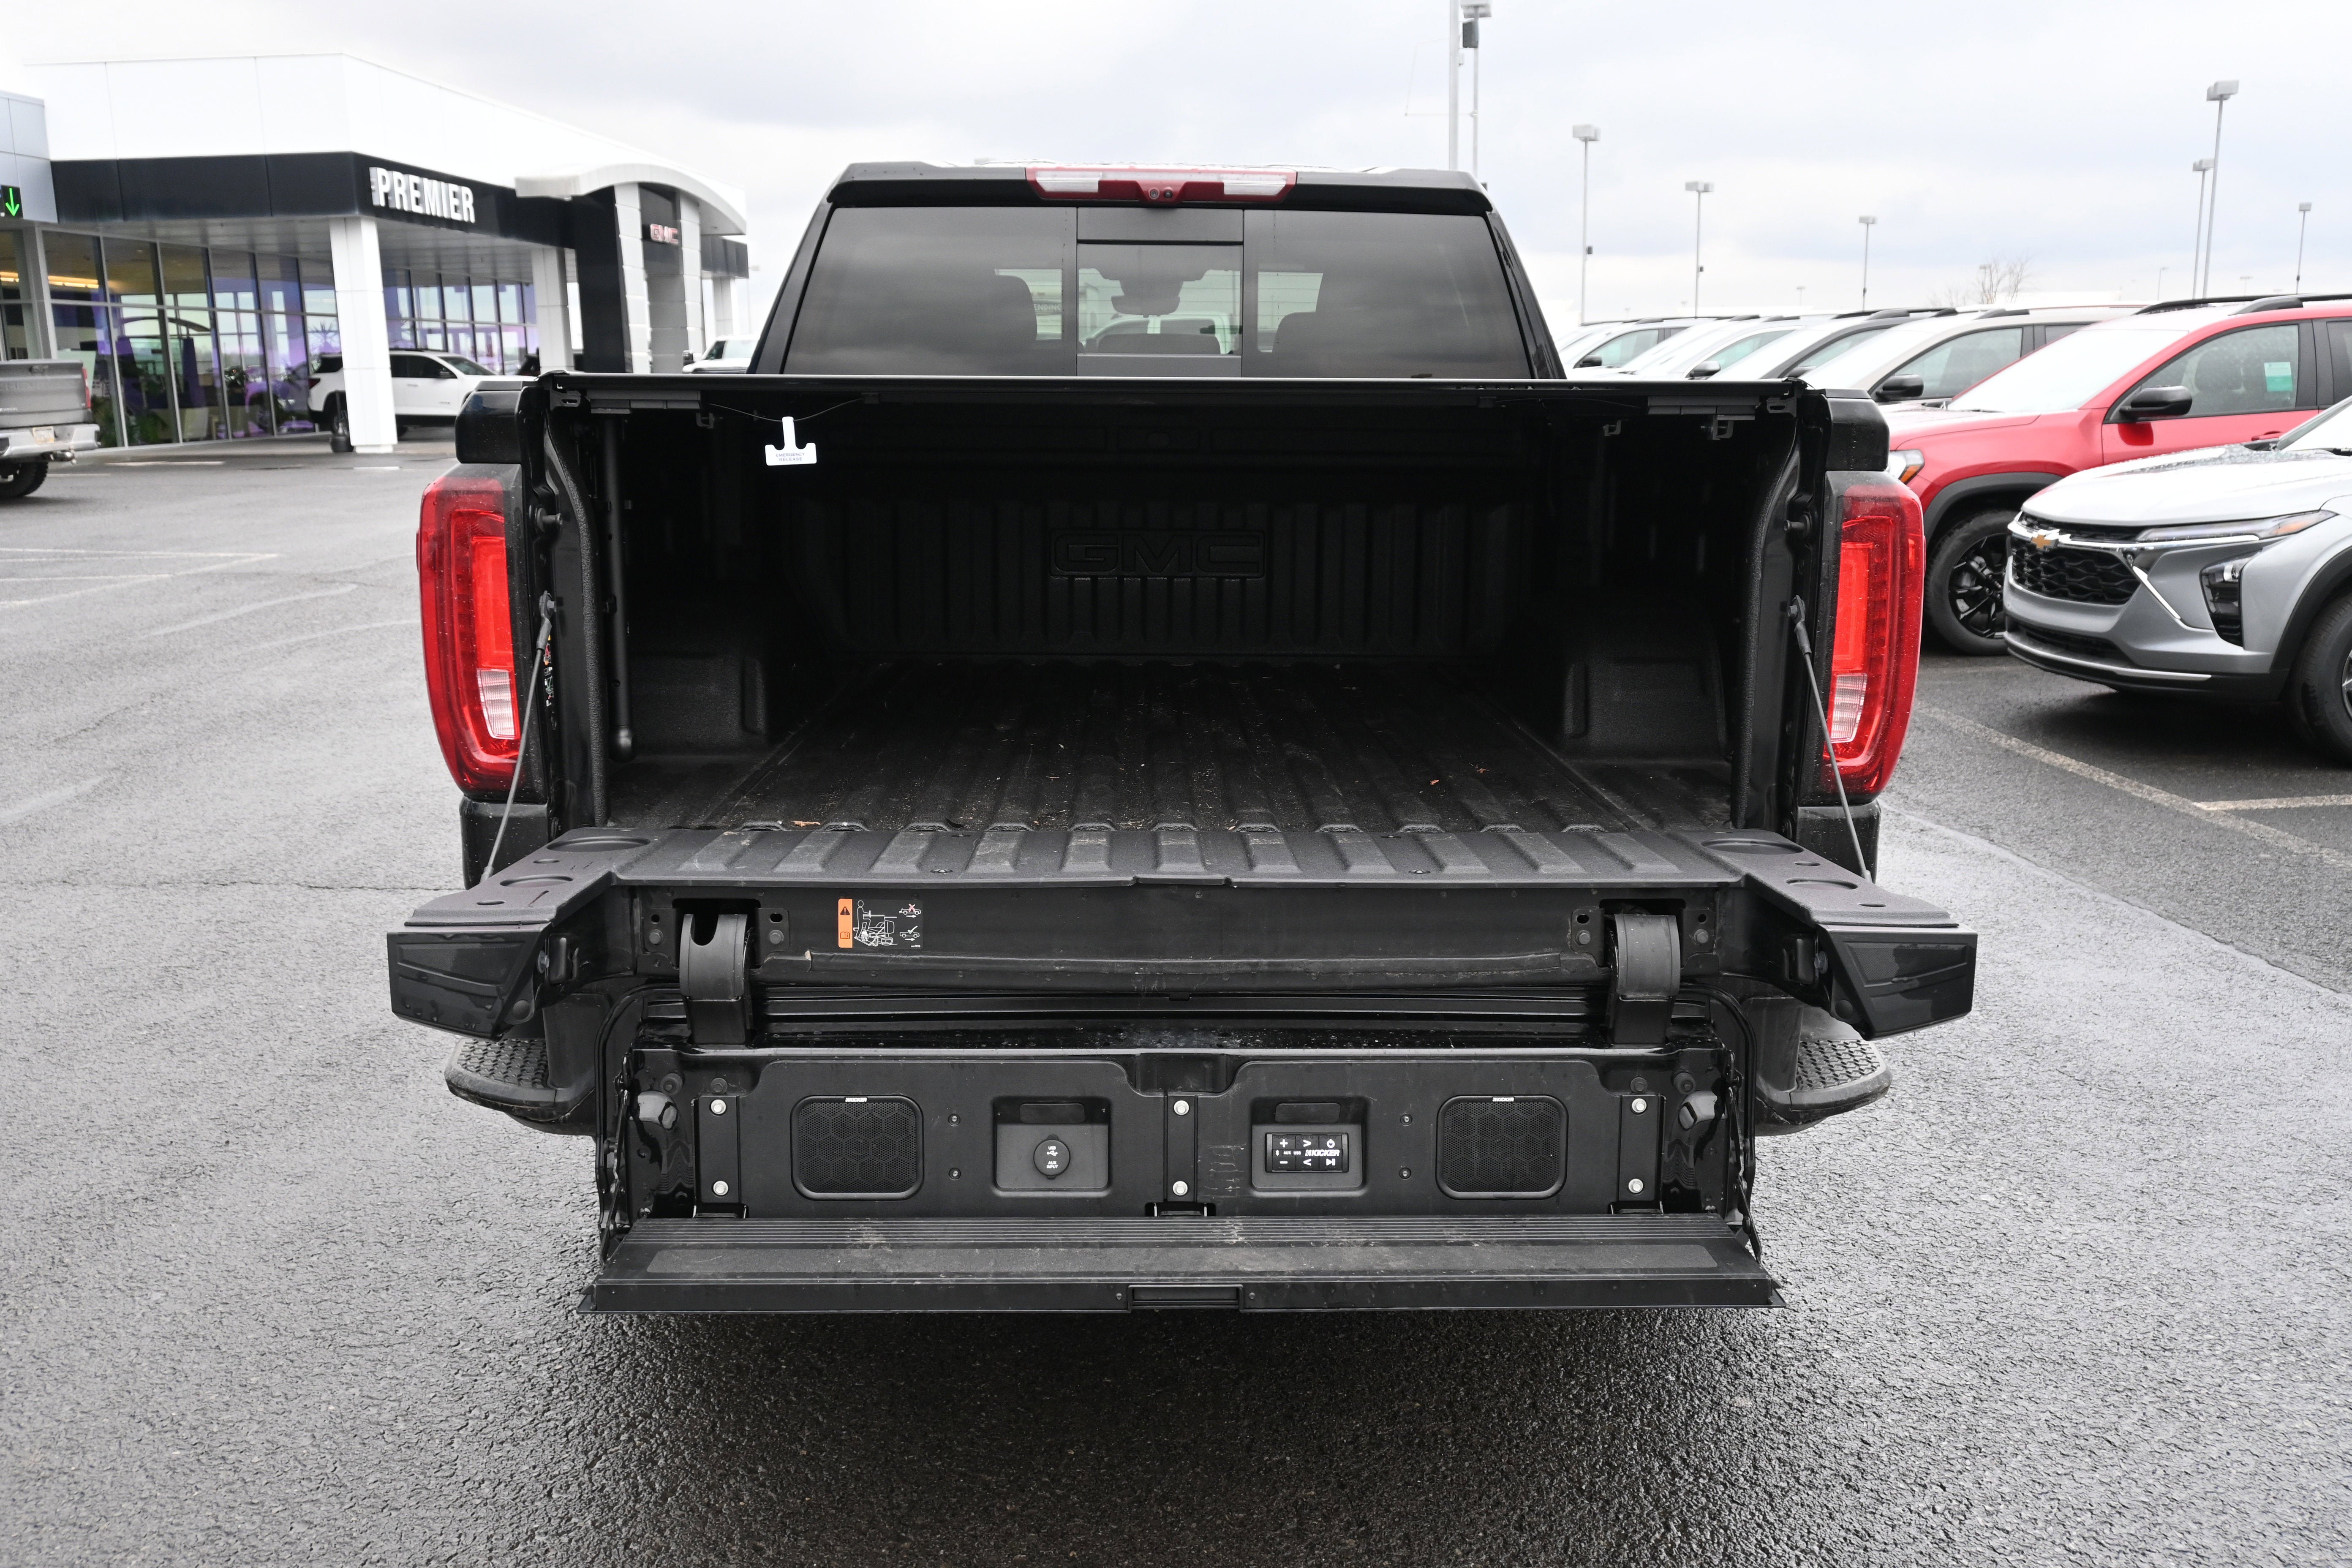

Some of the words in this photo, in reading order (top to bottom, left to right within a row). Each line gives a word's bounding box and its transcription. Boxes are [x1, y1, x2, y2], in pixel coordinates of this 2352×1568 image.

[369, 167, 475, 223] PREMIER
[651, 223, 678, 244] GMC
[1054, 534, 1260, 573] GMC
